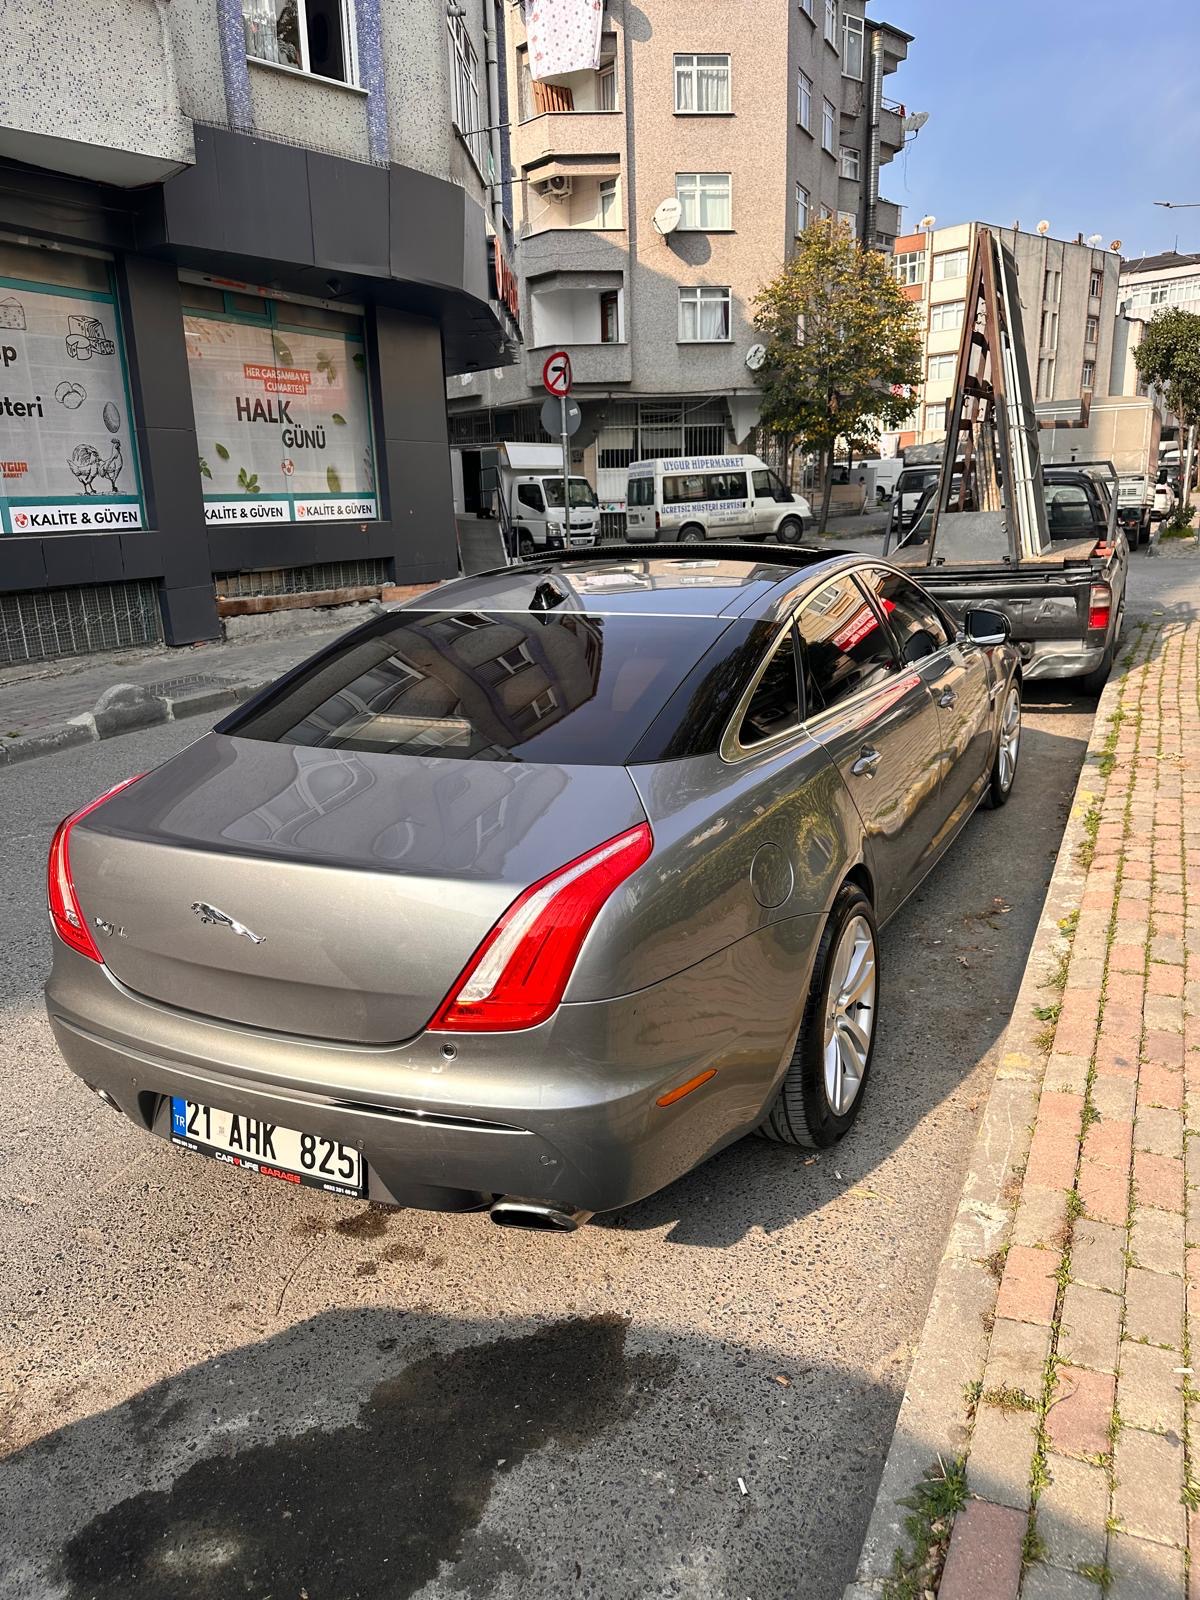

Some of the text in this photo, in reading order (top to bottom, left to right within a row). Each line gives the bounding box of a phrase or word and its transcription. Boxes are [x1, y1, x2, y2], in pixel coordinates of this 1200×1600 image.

[246, 367, 260, 377] HER
[300, 373, 309, 382] VE
[236, 396, 294, 425] HALK
[281, 423, 326, 449] GÜNÜ
[0, 462, 28, 472] YGUR
[663, 460, 691, 471] UYGUR
[692, 457, 744, 469] HİPERMARKET
[240, 508, 248, 518] &
[250, 504, 283, 518] GÜVEN
[306, 502, 373, 516] KALİTE & GÜVEN
[692, 501, 718, 512] MÜŞTERİ
[30, 508, 138, 527] KALİTE & GÜVEN
[174, 1101, 355, 1179] TR 21 AHK 825
[215, 1151, 234, 1165] CAR
[260, 1165, 301, 1184] GARAGE
